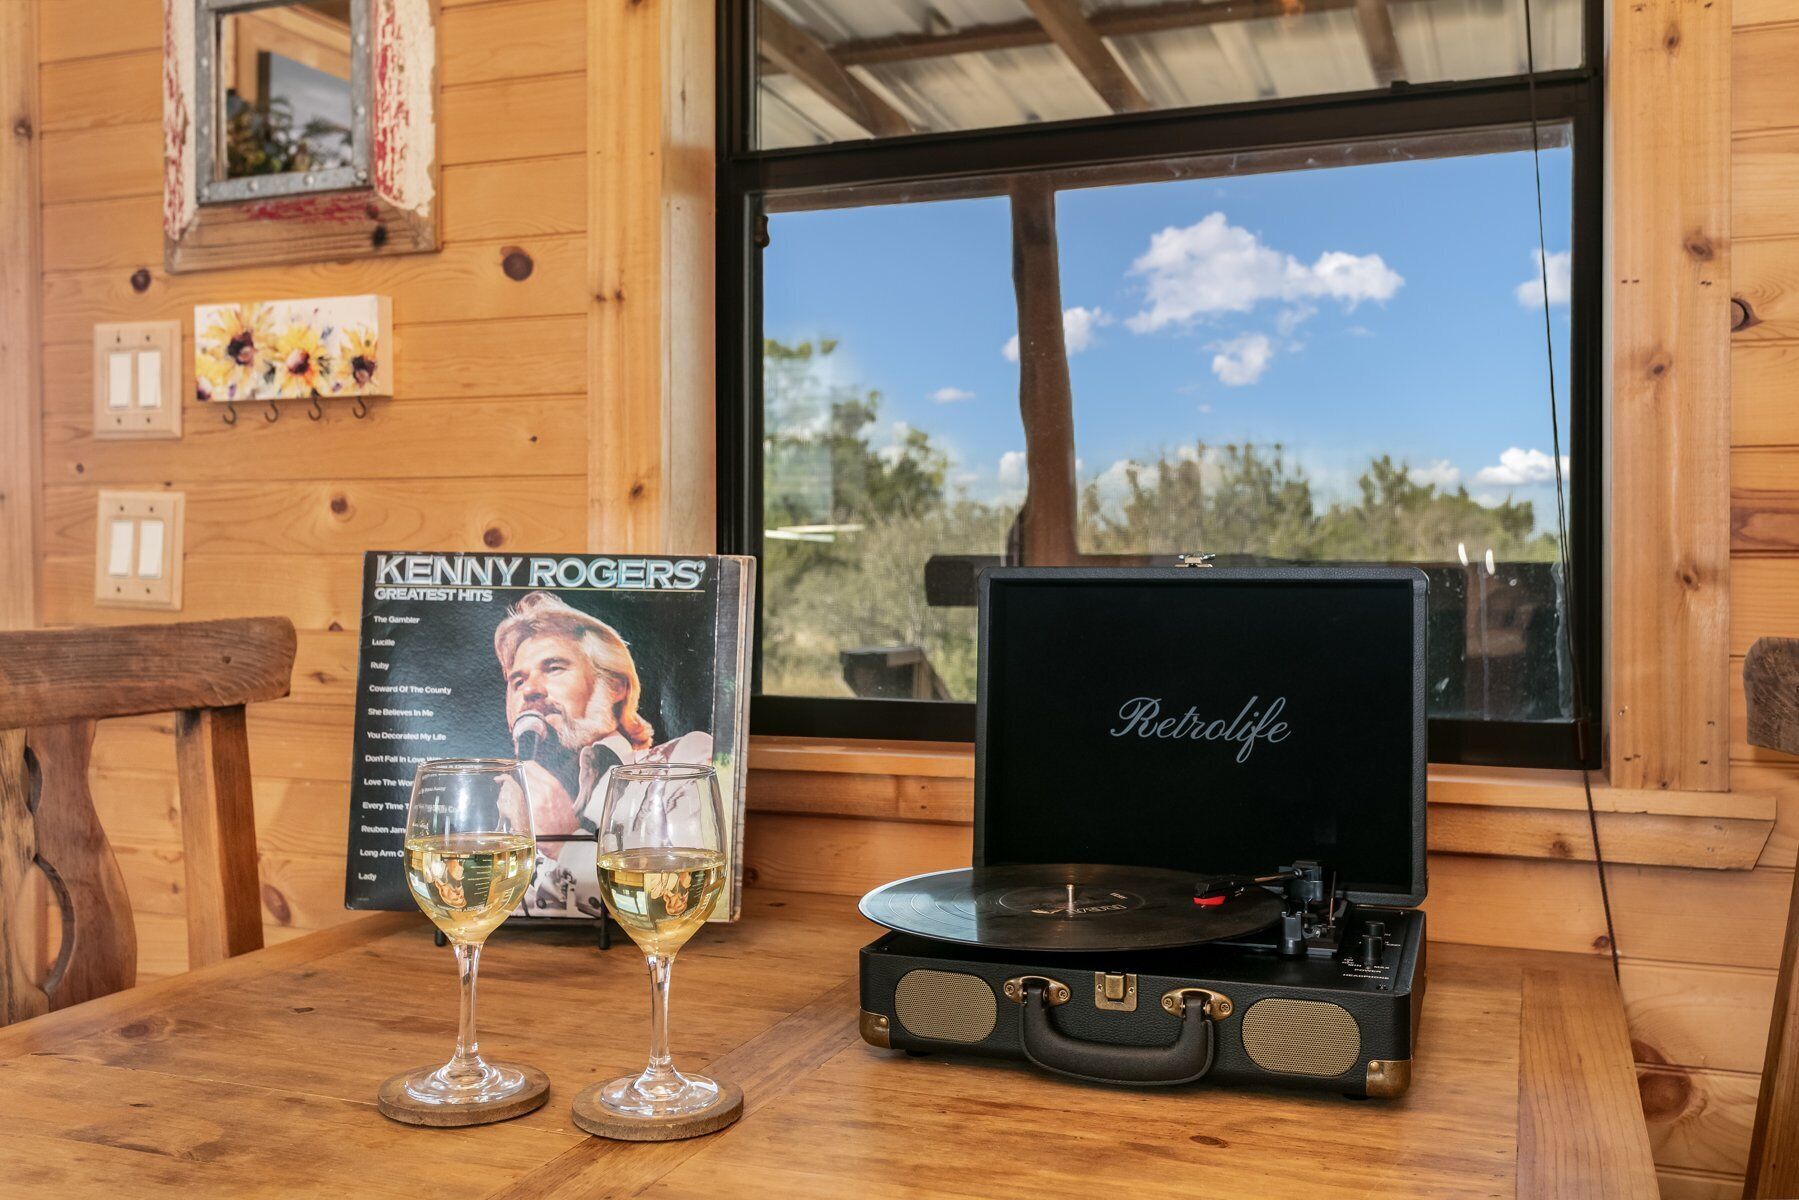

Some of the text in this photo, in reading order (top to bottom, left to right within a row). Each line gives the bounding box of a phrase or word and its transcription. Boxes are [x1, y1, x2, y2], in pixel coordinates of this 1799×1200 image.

[375, 554, 706, 589] KENNY ROGERS'
[374, 587, 493, 602] GREATEST HITS
[373, 615, 420, 623] The Gambler
[372, 638, 396, 646] Lucille
[370, 661, 390, 670] Ruby
[369, 684, 452, 695] Coward Of The County
[367, 707, 382, 716] She
[382, 708, 413, 716] Believes
[421, 709, 434, 717] Me
[1110, 695, 1292, 764] Retrolife
[367, 731, 447, 742] You Decorated My Life
[384, 755, 399, 763] Fall
[399, 755, 407, 763] In
[407, 756, 426, 764] Love
[363, 778, 382, 786] Love
[382, 778, 397, 787] The
[362, 801, 384, 811] Every
[384, 802, 404, 810] Time
[361, 825, 389, 834] Reuben
[360, 849, 379, 858] Long
[379, 849, 397, 857] Arm
[358, 873, 377, 881] Lady
